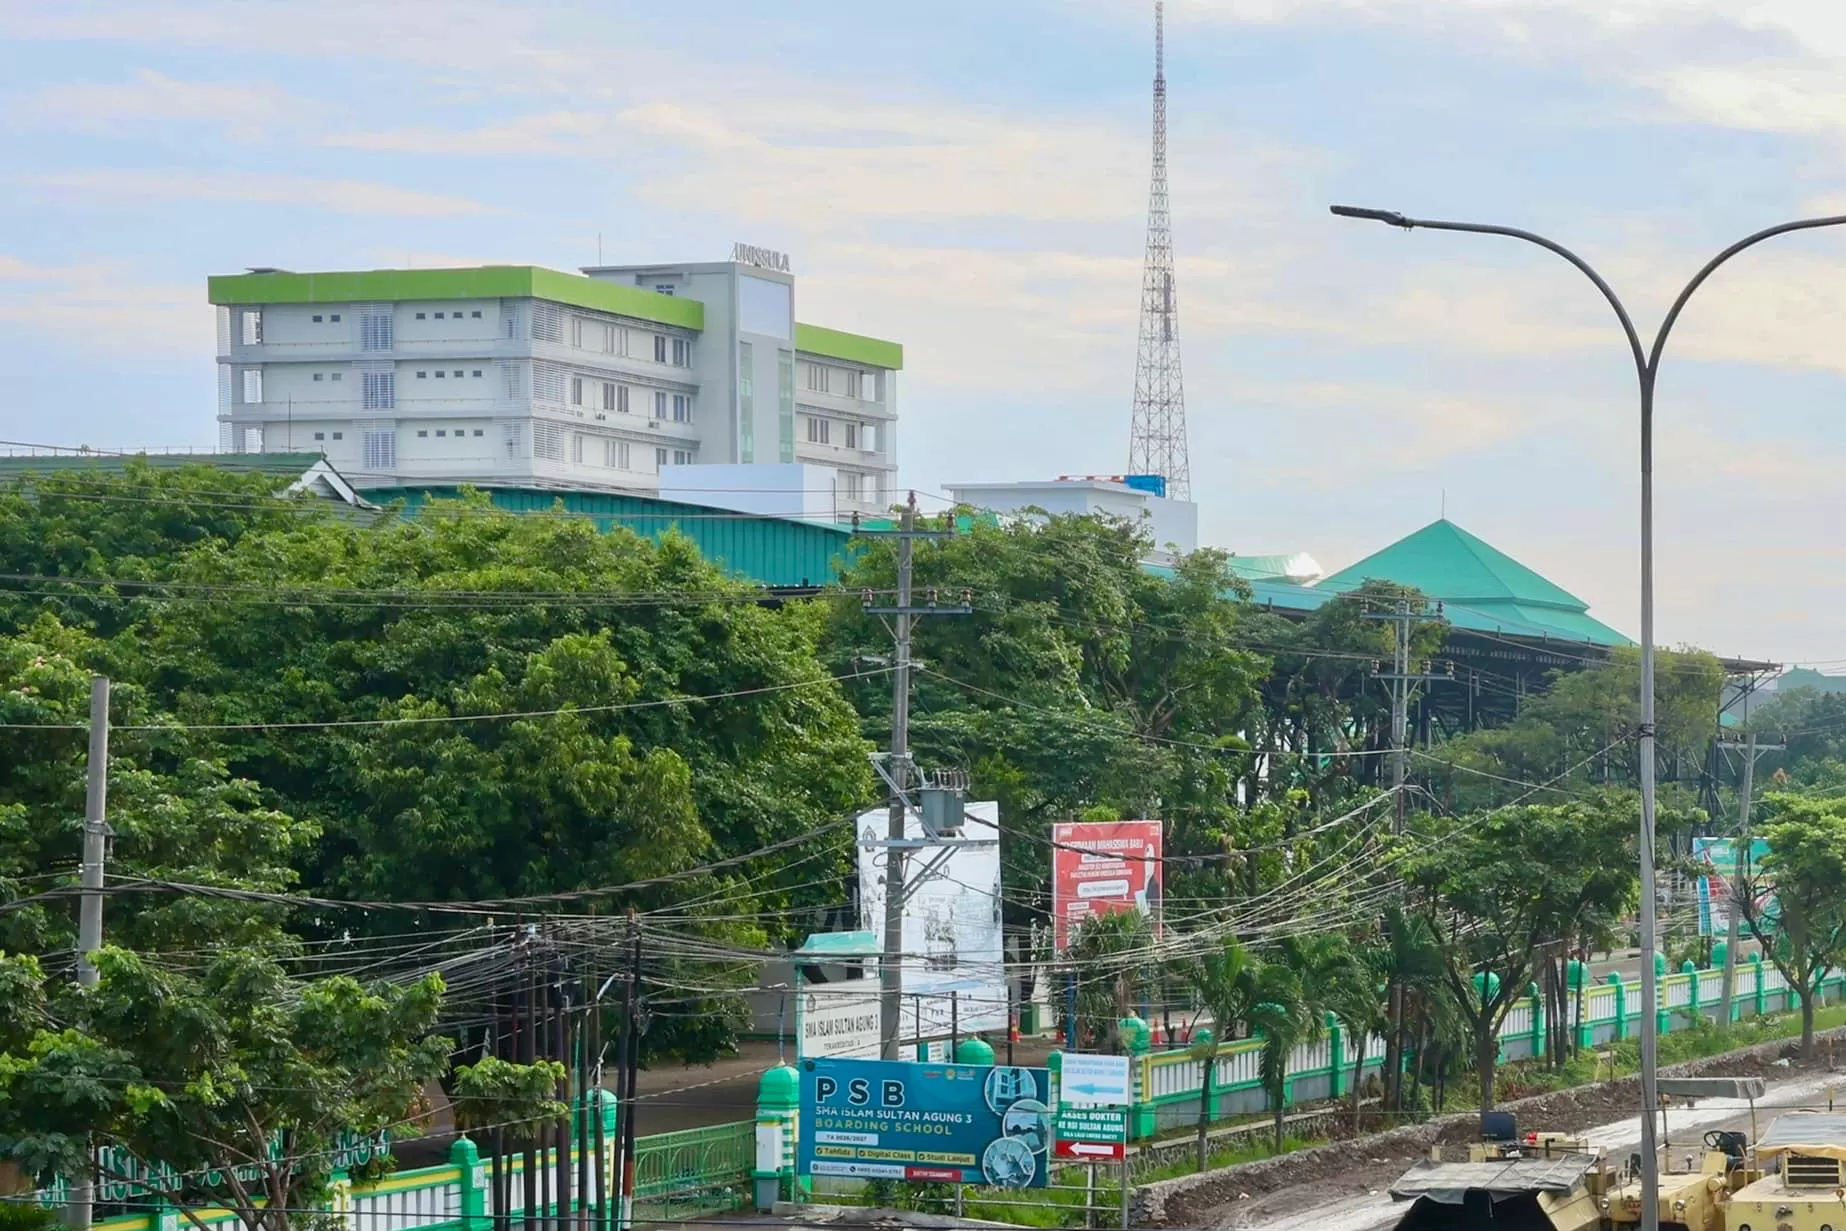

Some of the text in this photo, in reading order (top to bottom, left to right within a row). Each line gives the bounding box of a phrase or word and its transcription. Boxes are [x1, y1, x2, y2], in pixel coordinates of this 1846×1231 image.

[734, 241, 790, 273] UNISSULA
[834, 1016, 856, 1035] SULTAN
[856, 1014, 874, 1032] AGUNG
[815, 1107, 973, 1124] SMA ISLAM SULTAN AGUNG 3
[1089, 1112, 1121, 1121] DOKTER
[815, 1118, 953, 1136] BOARDING SCHOOL
[867, 1149, 912, 1160] Digital Class
